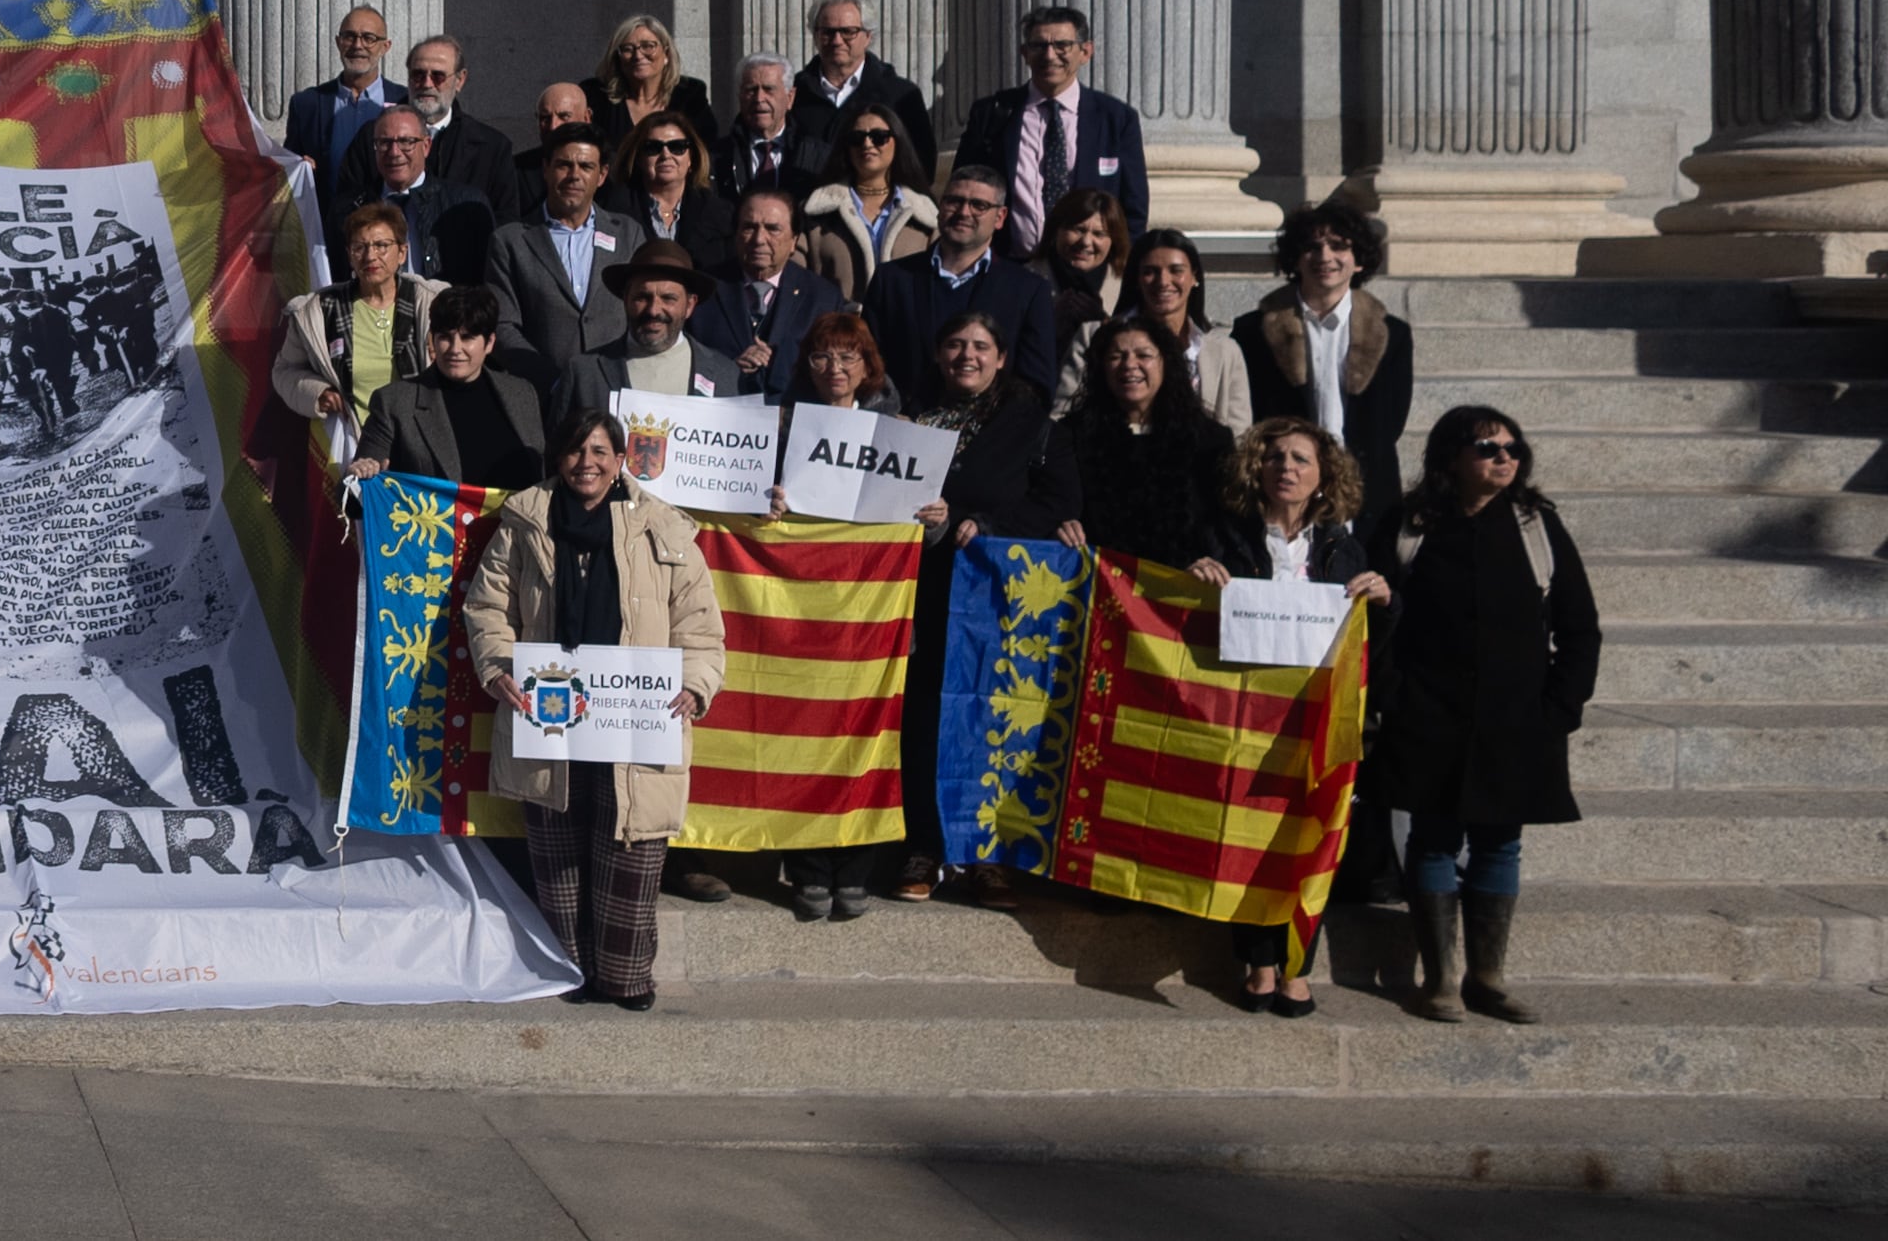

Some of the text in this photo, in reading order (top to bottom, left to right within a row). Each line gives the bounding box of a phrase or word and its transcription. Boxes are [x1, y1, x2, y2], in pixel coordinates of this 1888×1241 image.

[673, 426, 769, 451] CATADAU
[674, 451, 765, 471] RIBERA ALTA
[808, 438, 924, 481] ALBAL
[675, 474, 758, 496] (VALENCIA)
[589, 673, 672, 691] LLOMBAI
[592, 697, 671, 710] RIBERA ALTA
[594, 717, 667, 733] (VALENCIA)
[62, 955, 218, 985] valencians
